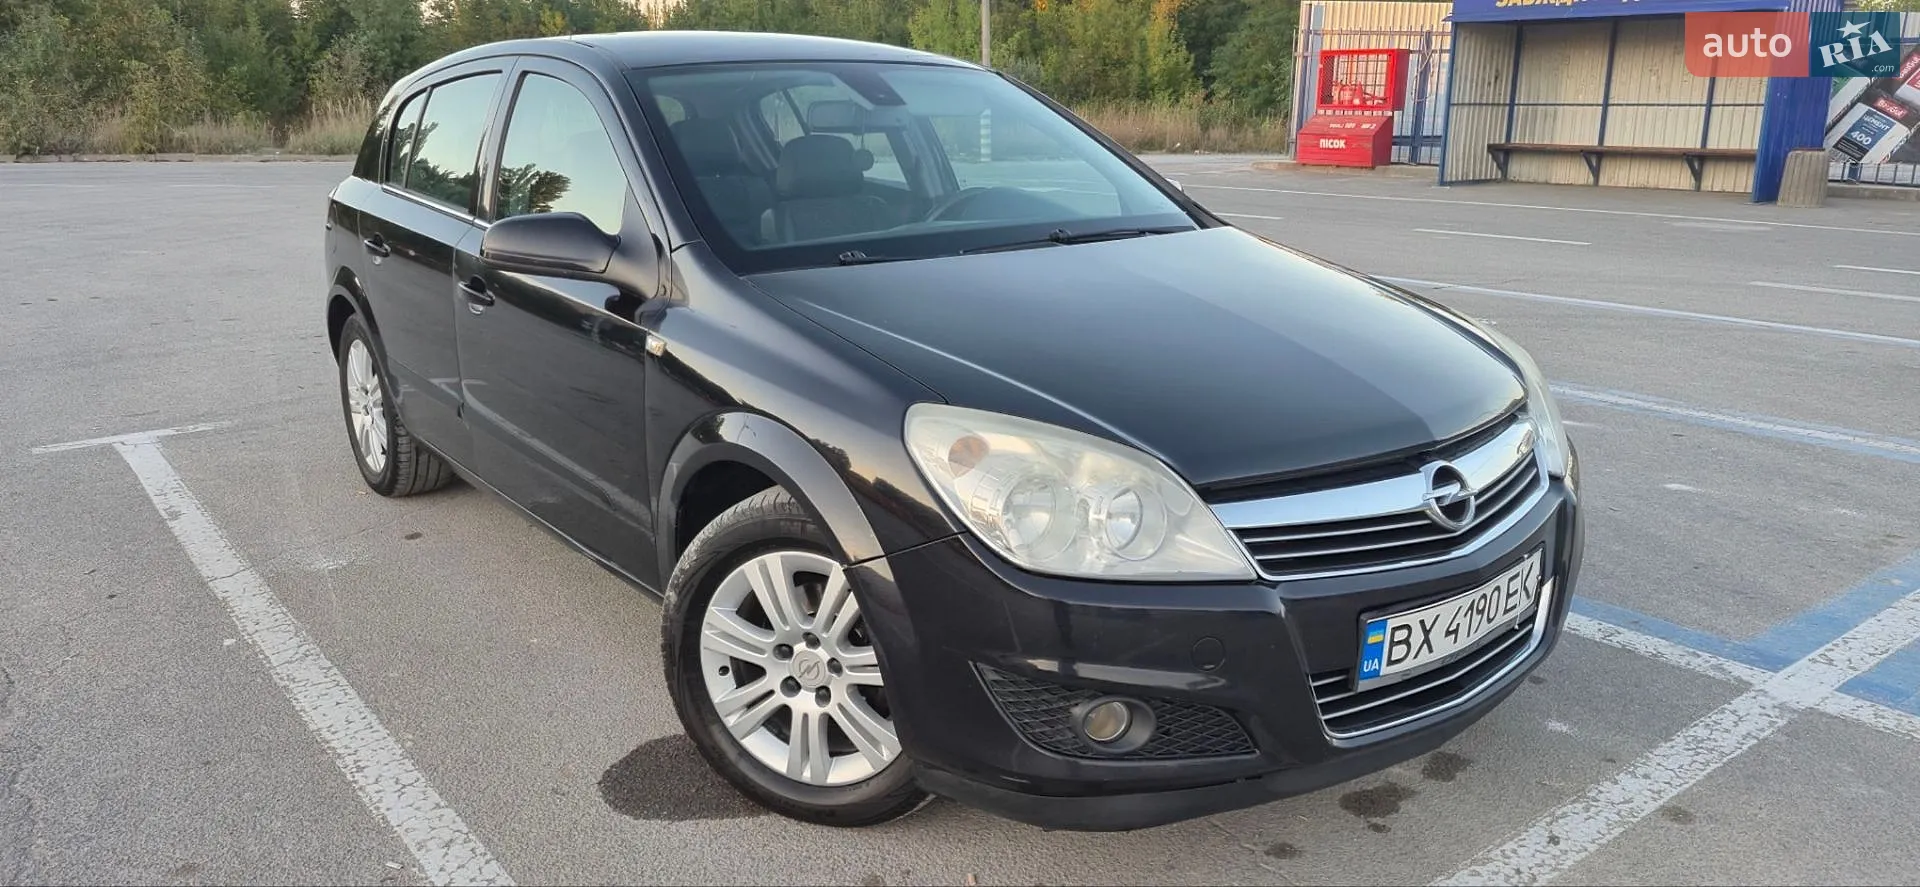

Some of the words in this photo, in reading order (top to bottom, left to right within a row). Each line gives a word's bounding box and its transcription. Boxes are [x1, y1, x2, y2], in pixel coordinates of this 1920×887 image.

[1320, 138, 1346, 149] ПІСОК
[1851, 131, 1872, 145] 400
[1386, 614, 1440, 668] BX
[1444, 585, 1501, 645] 4190
[1503, 562, 1535, 617] EK
[1363, 660, 1379, 673] UA
